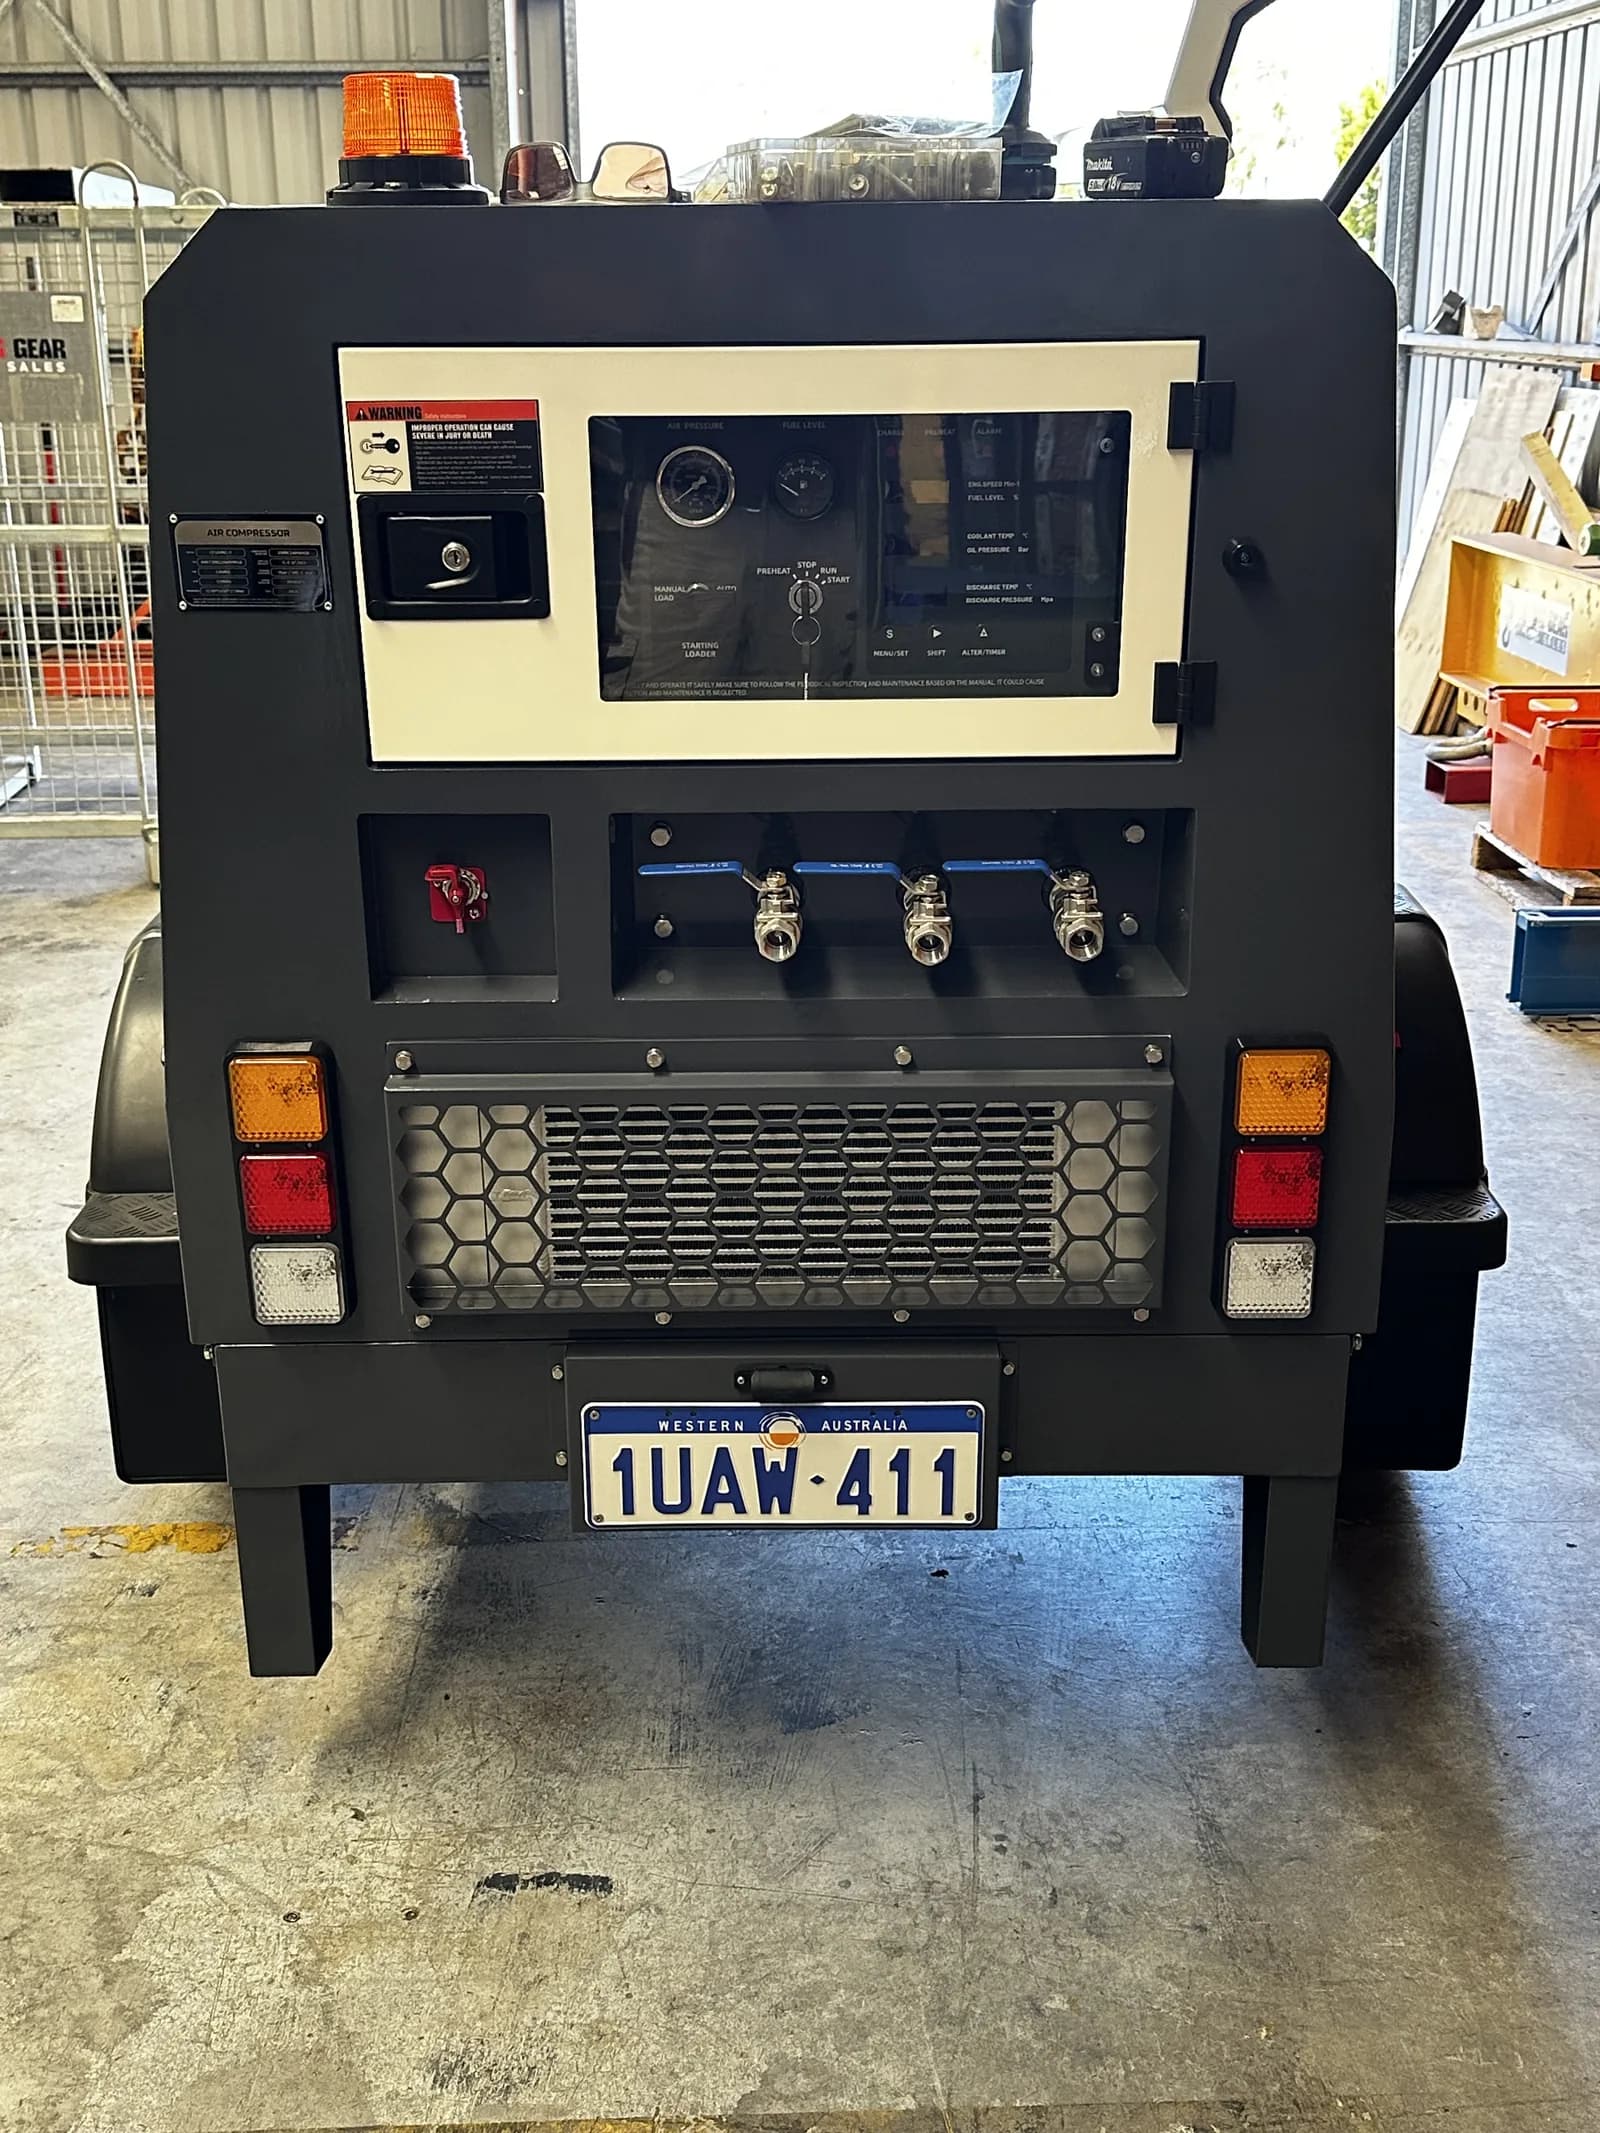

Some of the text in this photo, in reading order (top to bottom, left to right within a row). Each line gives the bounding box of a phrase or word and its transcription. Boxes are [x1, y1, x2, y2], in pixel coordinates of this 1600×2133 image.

[13, 338, 67, 359] GEAR
[7, 361, 66, 373] SALES
[368, 406, 422, 420] WARNING
[411, 424, 443, 432] IMPROPER
[444, 424, 478, 432] OPERATION
[493, 423, 514, 431] CAUSE
[667, 421, 725, 430] AIR PRESSURE
[782, 420, 825, 429] FUEL LEVEL
[444, 432, 462, 440] JURY
[207, 528, 290, 537] AIR COMPRESSOR
[967, 532, 997, 540] COOLANT
[998, 532, 1015, 540] TEMP
[797, 561, 817, 569] STOP
[756, 567, 837, 575] PREHEAT RUN
[827, 575, 850, 584] START
[654, 585, 687, 593] MANUAL
[966, 583, 1001, 591] DISCHARGE
[654, 594, 674, 602] LOAD
[681, 641, 720, 650] STARTING
[684, 649, 717, 658] LOADER
[873, 648, 1006, 658] MENU/SET SHIFT ALTER/TIMER
[1003, 678, 1024, 686] COULD
[1025, 678, 1044, 686] CAUSE
[658, 1418, 909, 1432] WESTERN AUSTRALIA
